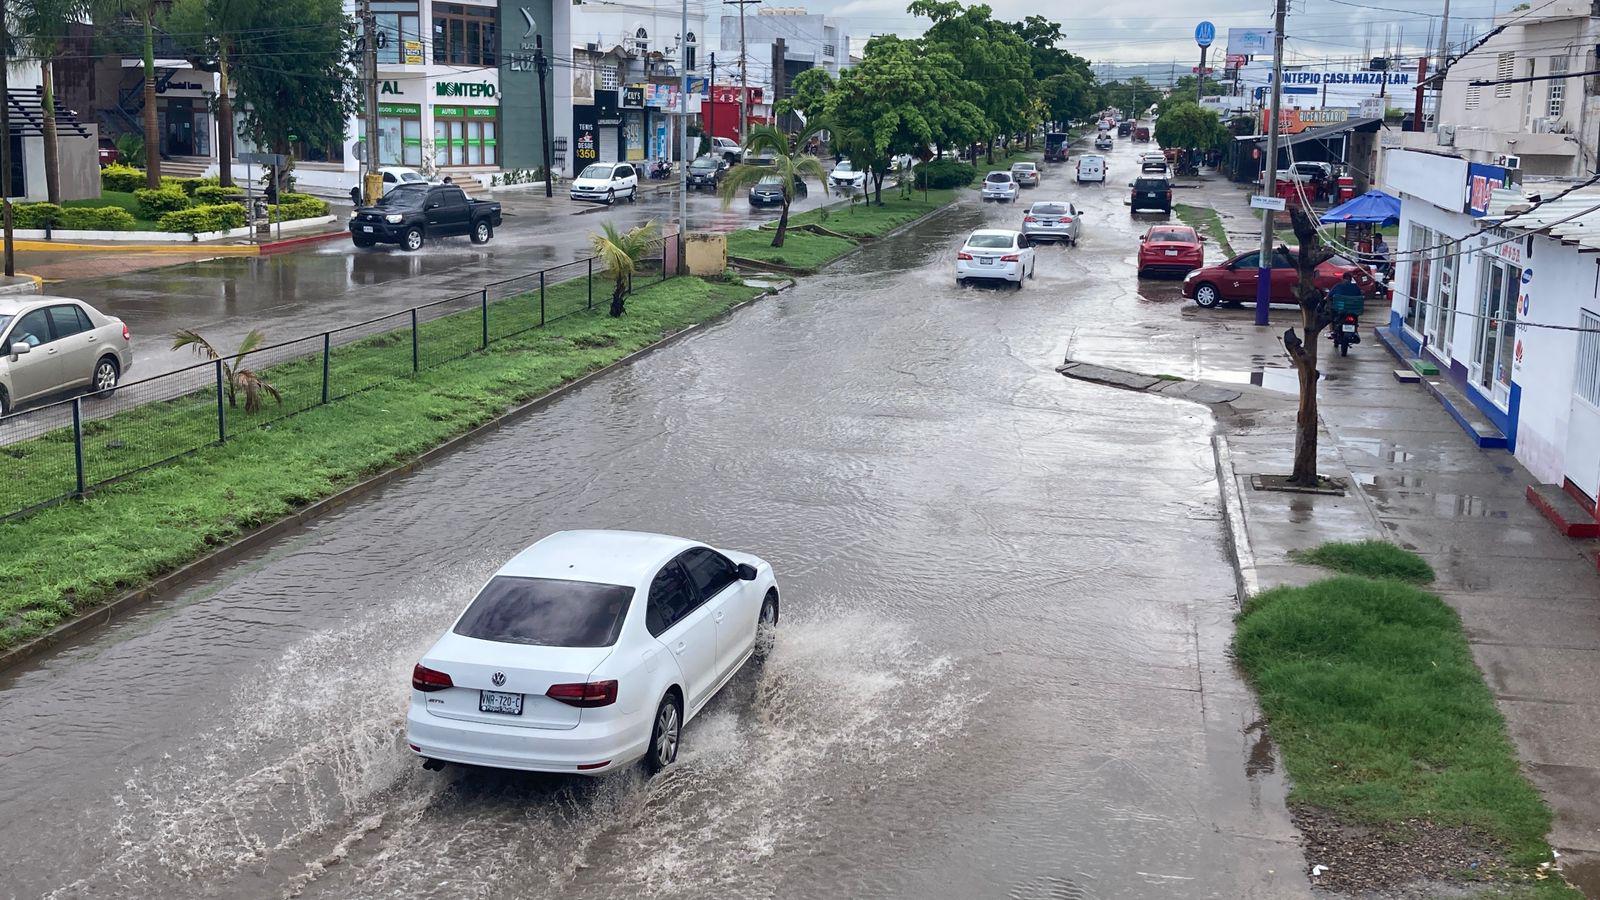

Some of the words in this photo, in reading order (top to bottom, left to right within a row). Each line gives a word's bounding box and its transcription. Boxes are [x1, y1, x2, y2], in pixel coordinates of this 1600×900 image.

[1323, 73, 1350, 83] CASA
[436, 80, 496, 97] MONTEPÍO
[1298, 110, 1346, 122] BICENTENARIO
[577, 149, 596, 159] $350
[482, 693, 520, 708] VNR-720-C
